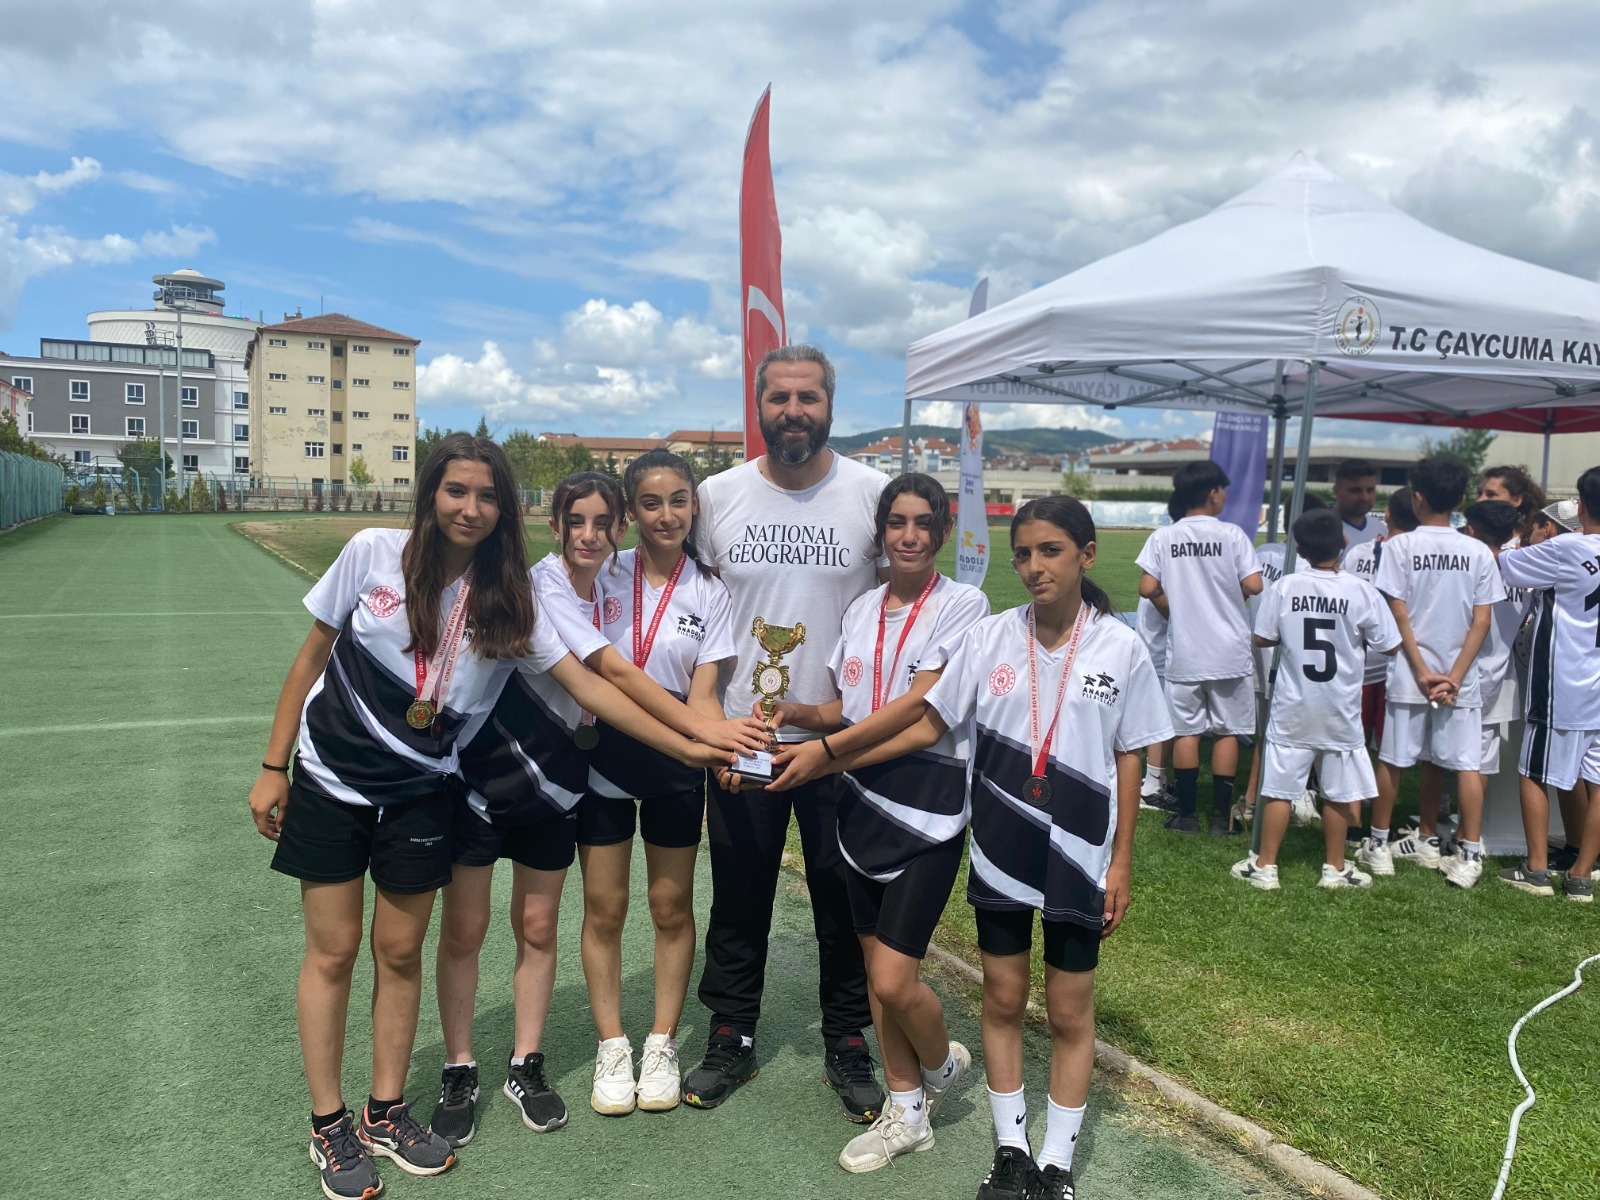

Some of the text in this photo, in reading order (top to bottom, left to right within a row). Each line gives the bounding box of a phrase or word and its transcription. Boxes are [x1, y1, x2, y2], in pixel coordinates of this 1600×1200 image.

[1436, 330, 1554, 362] ÇAYCUMA
[744, 524, 840, 545] NATIONAL
[728, 544, 850, 567] GEOGRAPHIC
[1170, 542, 1222, 558] BATMAN
[1413, 554, 1470, 572] BATMAN
[1292, 596, 1349, 616] BATMAN
[1302, 618, 1338, 682] 5
[1083, 686, 1116, 704] ANADOLU
